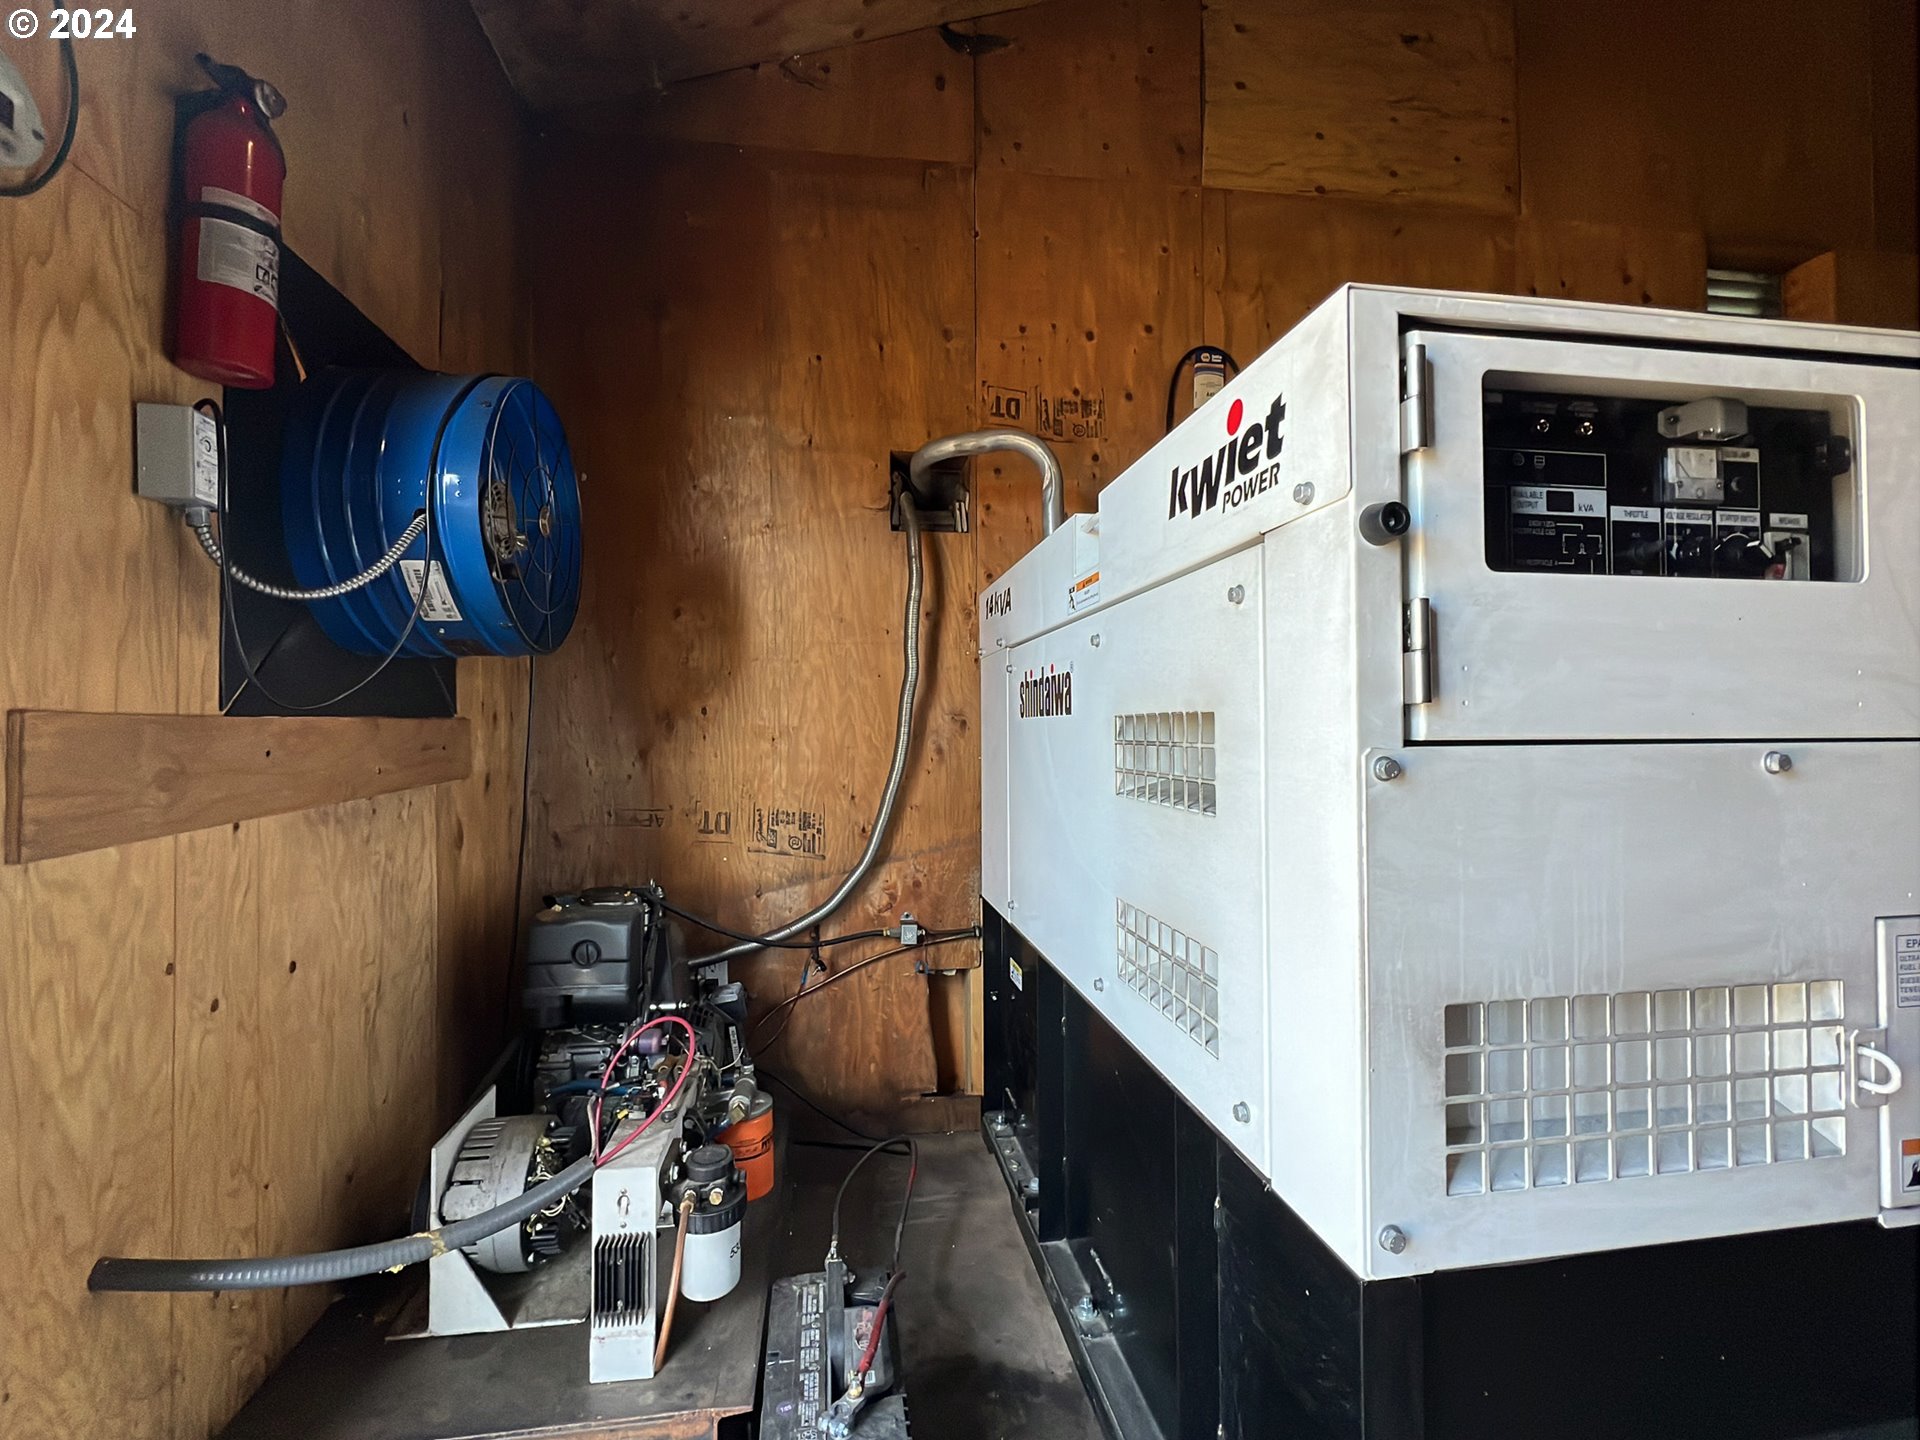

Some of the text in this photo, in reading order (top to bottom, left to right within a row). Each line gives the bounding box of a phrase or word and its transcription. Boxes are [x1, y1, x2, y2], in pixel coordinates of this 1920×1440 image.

[1168, 392, 1287, 520] kwiet
[1222, 462, 1281, 513] POWER
[1578, 503, 1594, 512] kVA
[1019, 663, 1072, 718] shindaiwa
